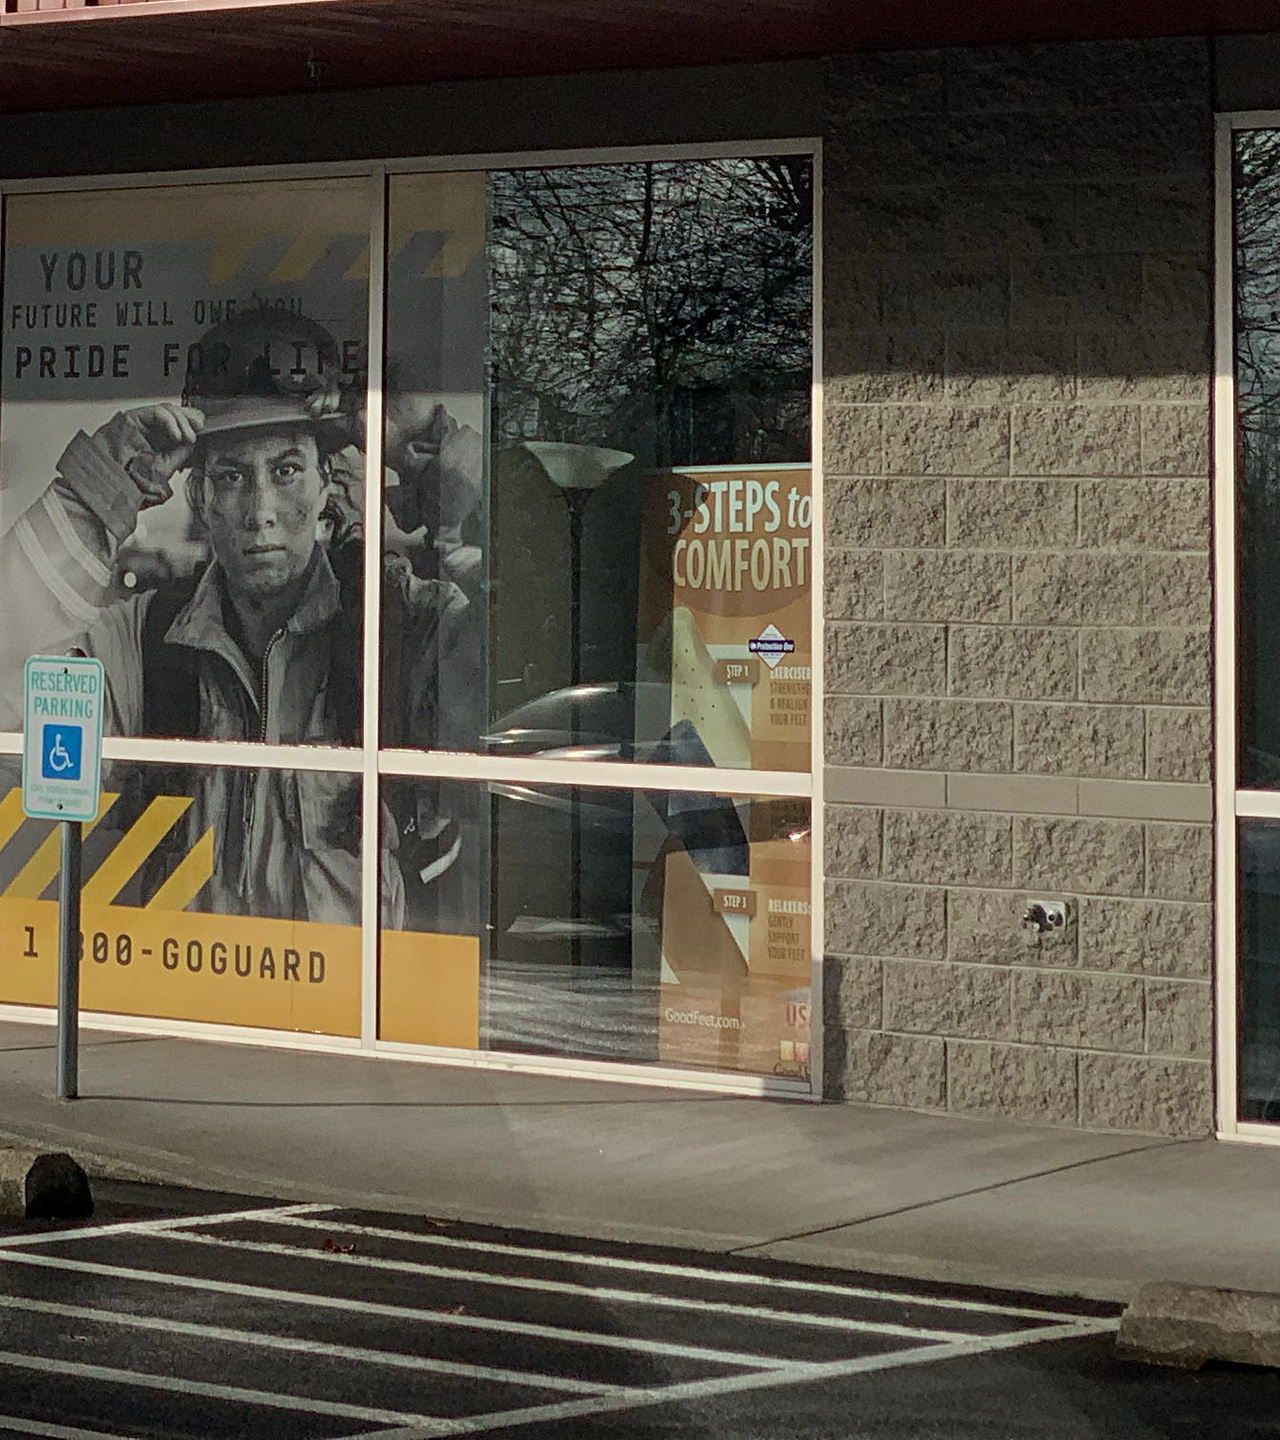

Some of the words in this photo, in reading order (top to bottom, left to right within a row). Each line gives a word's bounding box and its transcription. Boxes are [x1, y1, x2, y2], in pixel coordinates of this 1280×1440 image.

[39, 249, 144, 293] YOUR
[11, 301, 97, 330] FUTURE
[116, 299, 174, 328] WILL
[15, 343, 130, 379] PRIDE
[667, 480, 781, 535] 3-STEPS
[788, 487, 812, 528] to
[674, 537, 810, 591] COMFORT
[31, 671, 97, 694] RESERVED
[727, 664, 742, 679] STEP
[34, 697, 93, 719] PARKING
[724, 895, 740, 908] STEP
[24, 926, 38, 958] 1
